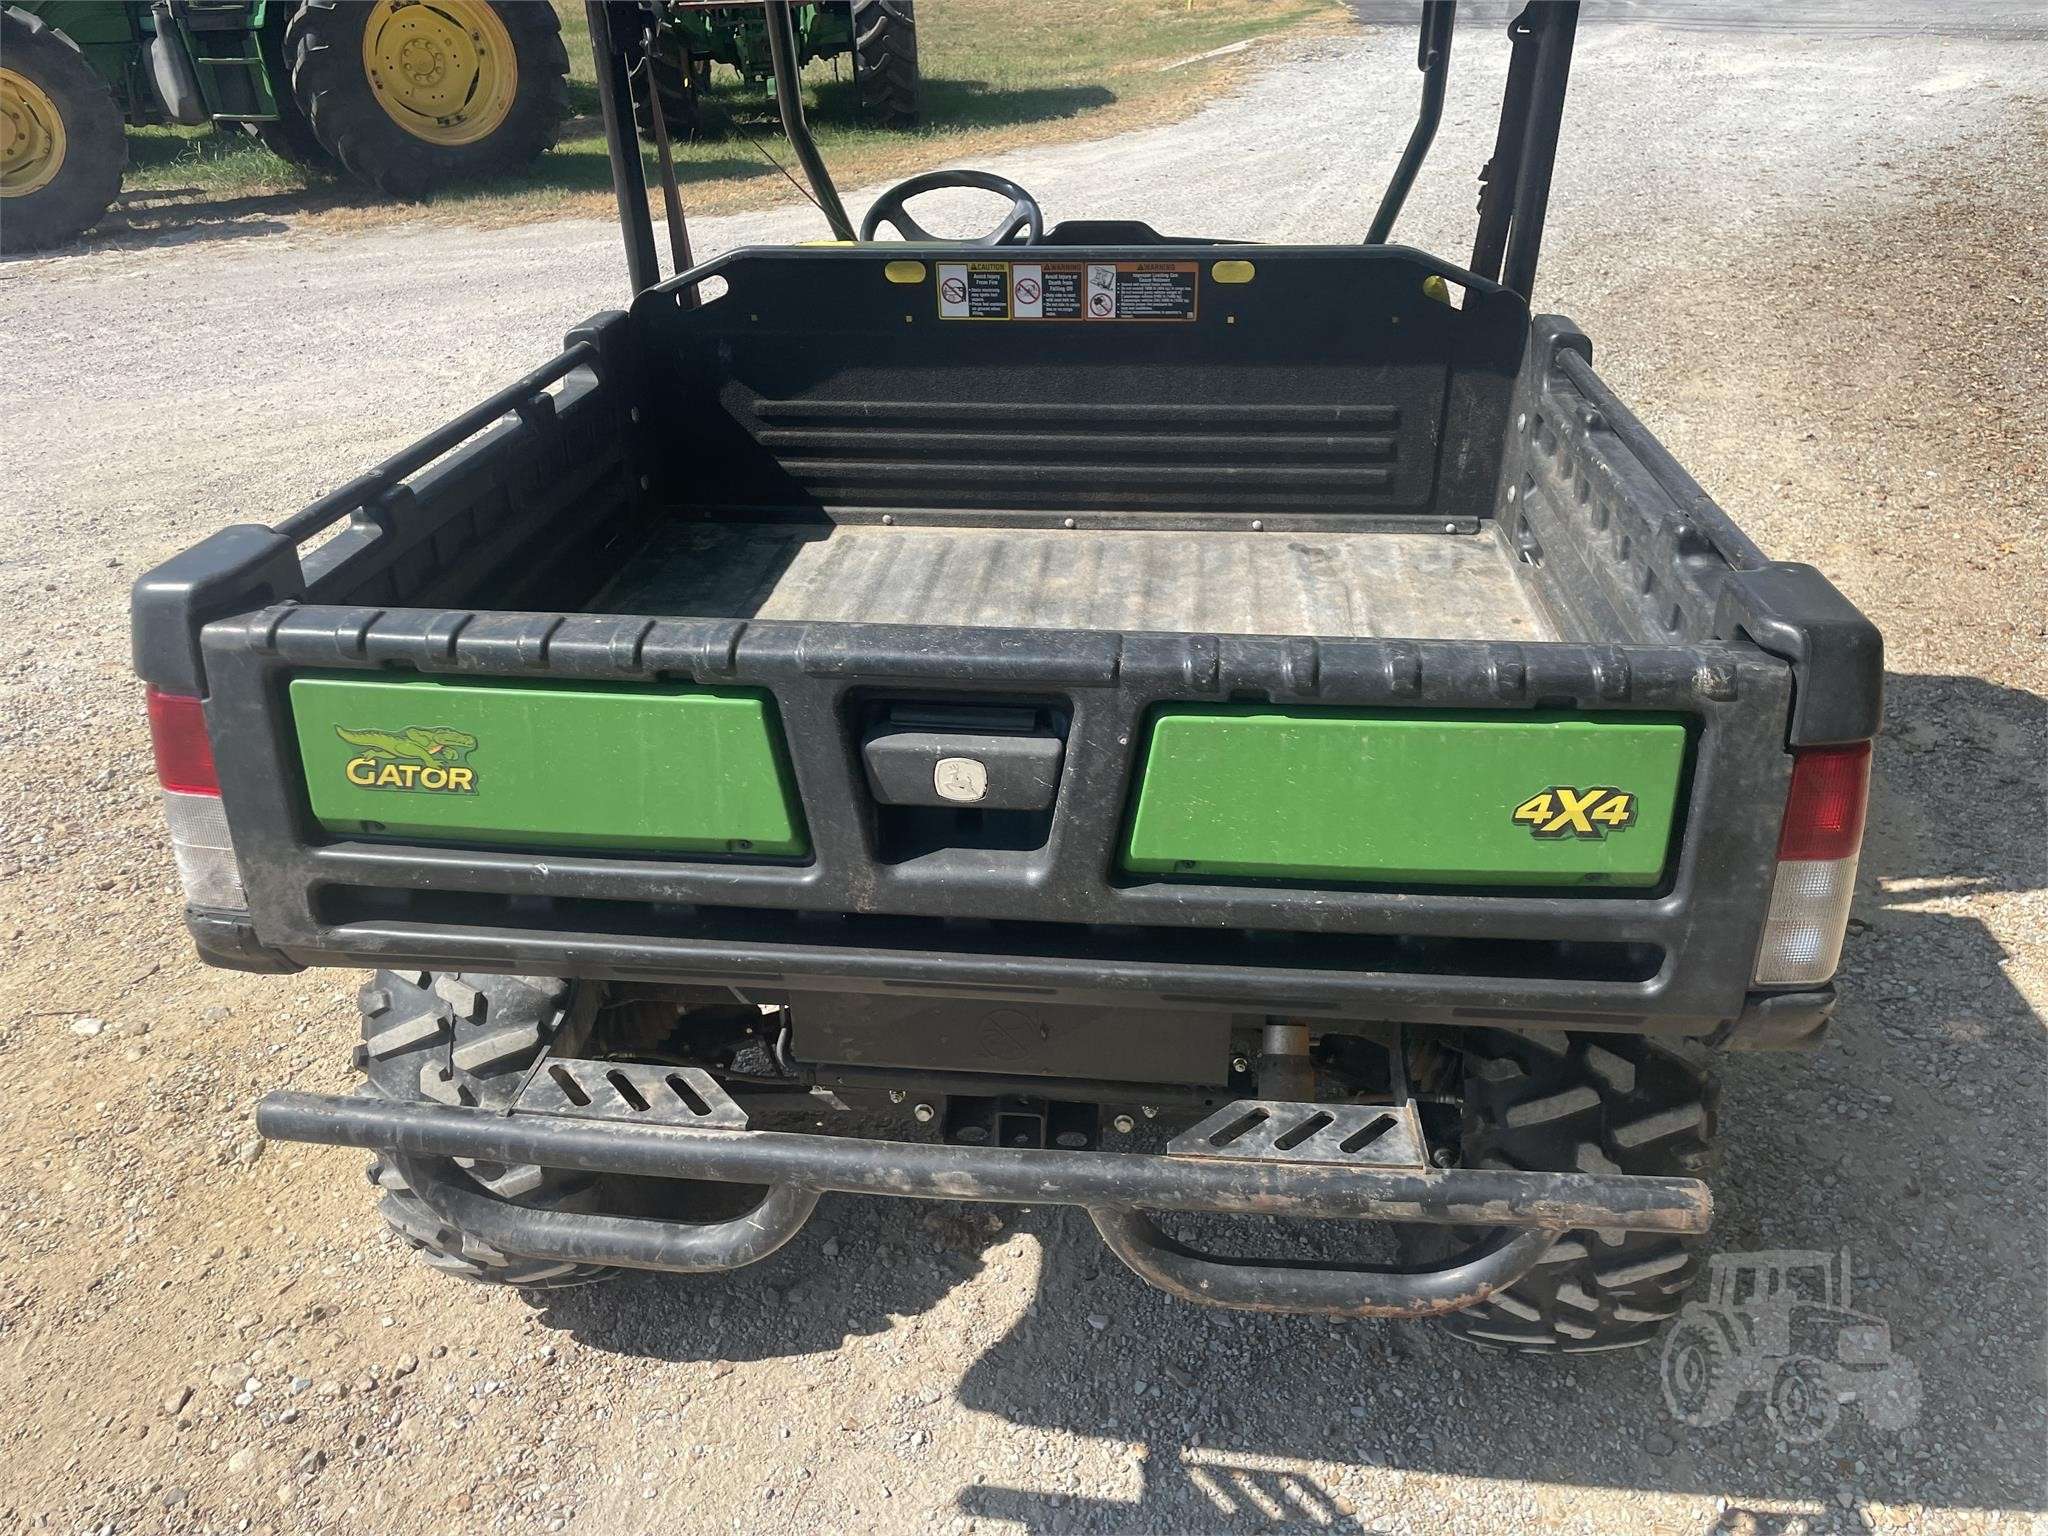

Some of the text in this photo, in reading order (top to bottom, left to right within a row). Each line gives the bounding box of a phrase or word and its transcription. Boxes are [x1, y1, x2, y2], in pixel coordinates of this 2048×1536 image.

[1049, 263, 1081, 271] WARNING
[346, 757, 474, 791] GATOR
[1514, 788, 1630, 832] 4X4
